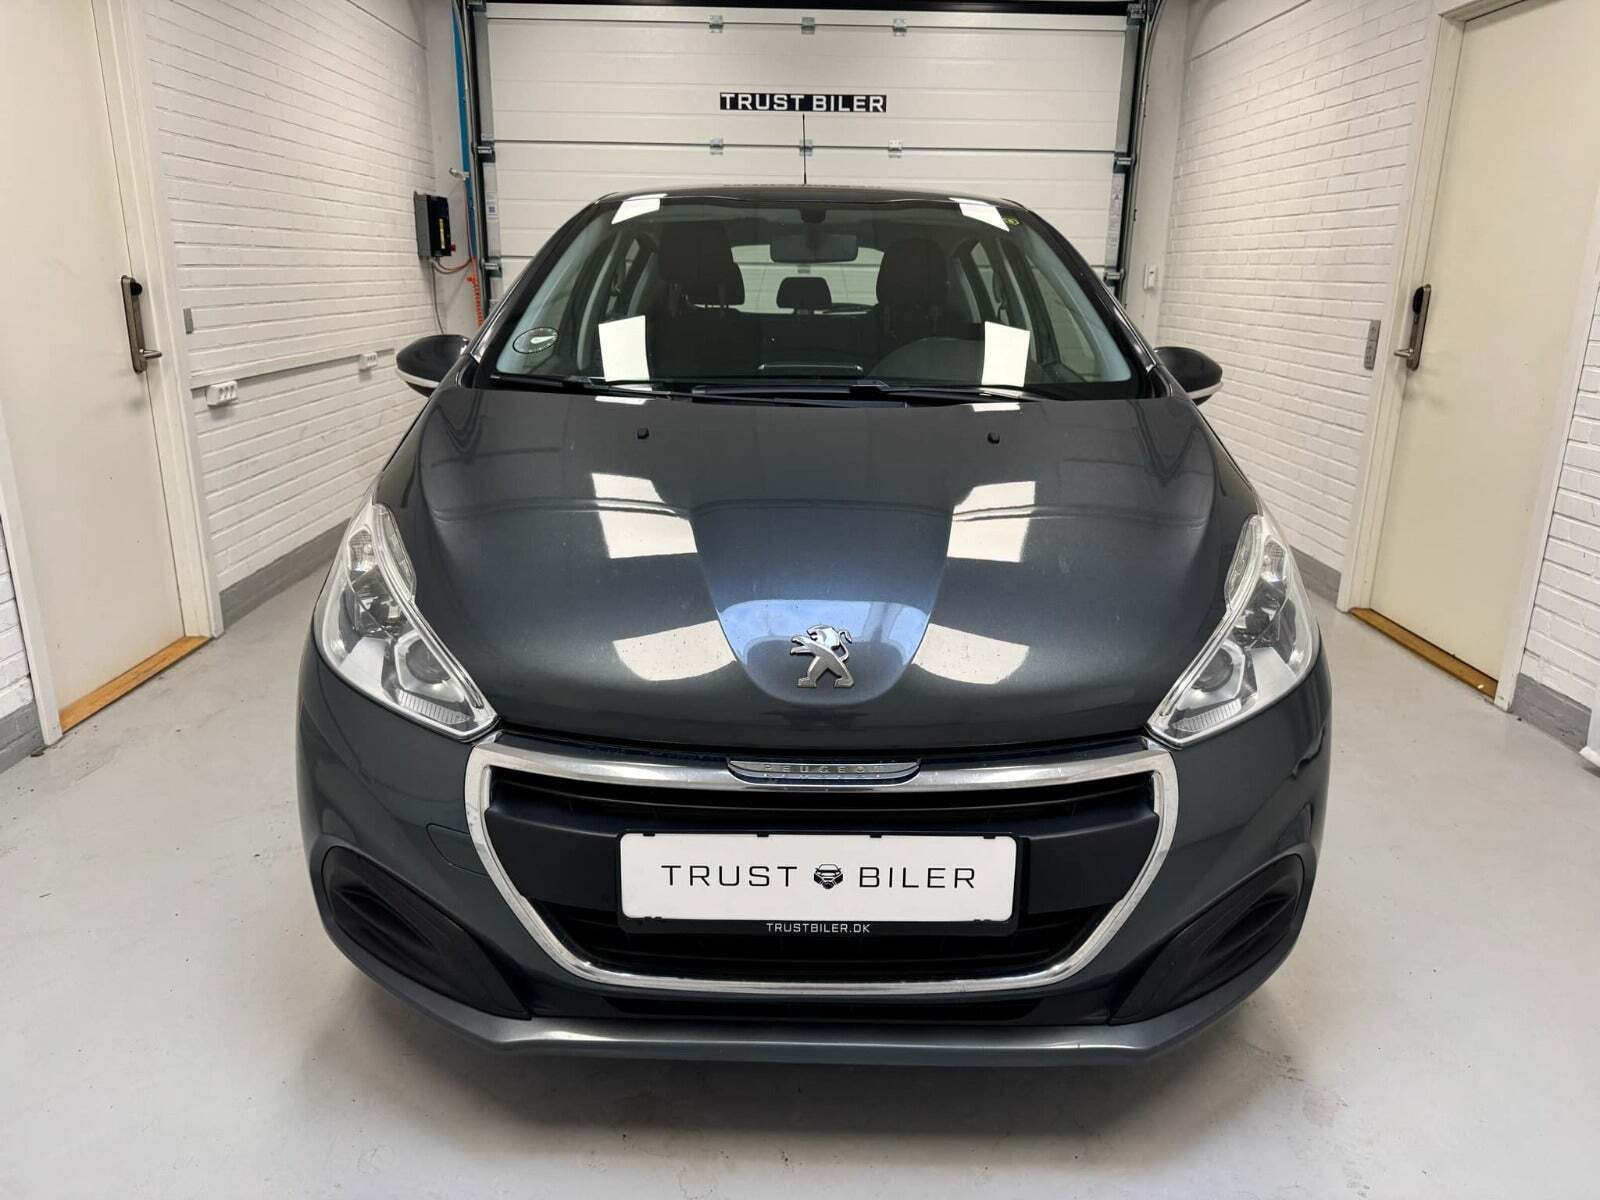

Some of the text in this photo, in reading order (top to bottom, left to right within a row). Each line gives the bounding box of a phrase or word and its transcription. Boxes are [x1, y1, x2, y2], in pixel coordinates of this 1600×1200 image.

[721, 94, 884, 112] TRUST BILER
[660, 864, 976, 889] TRUST BILER
[766, 922, 871, 934] TRUSTBILER.DK
